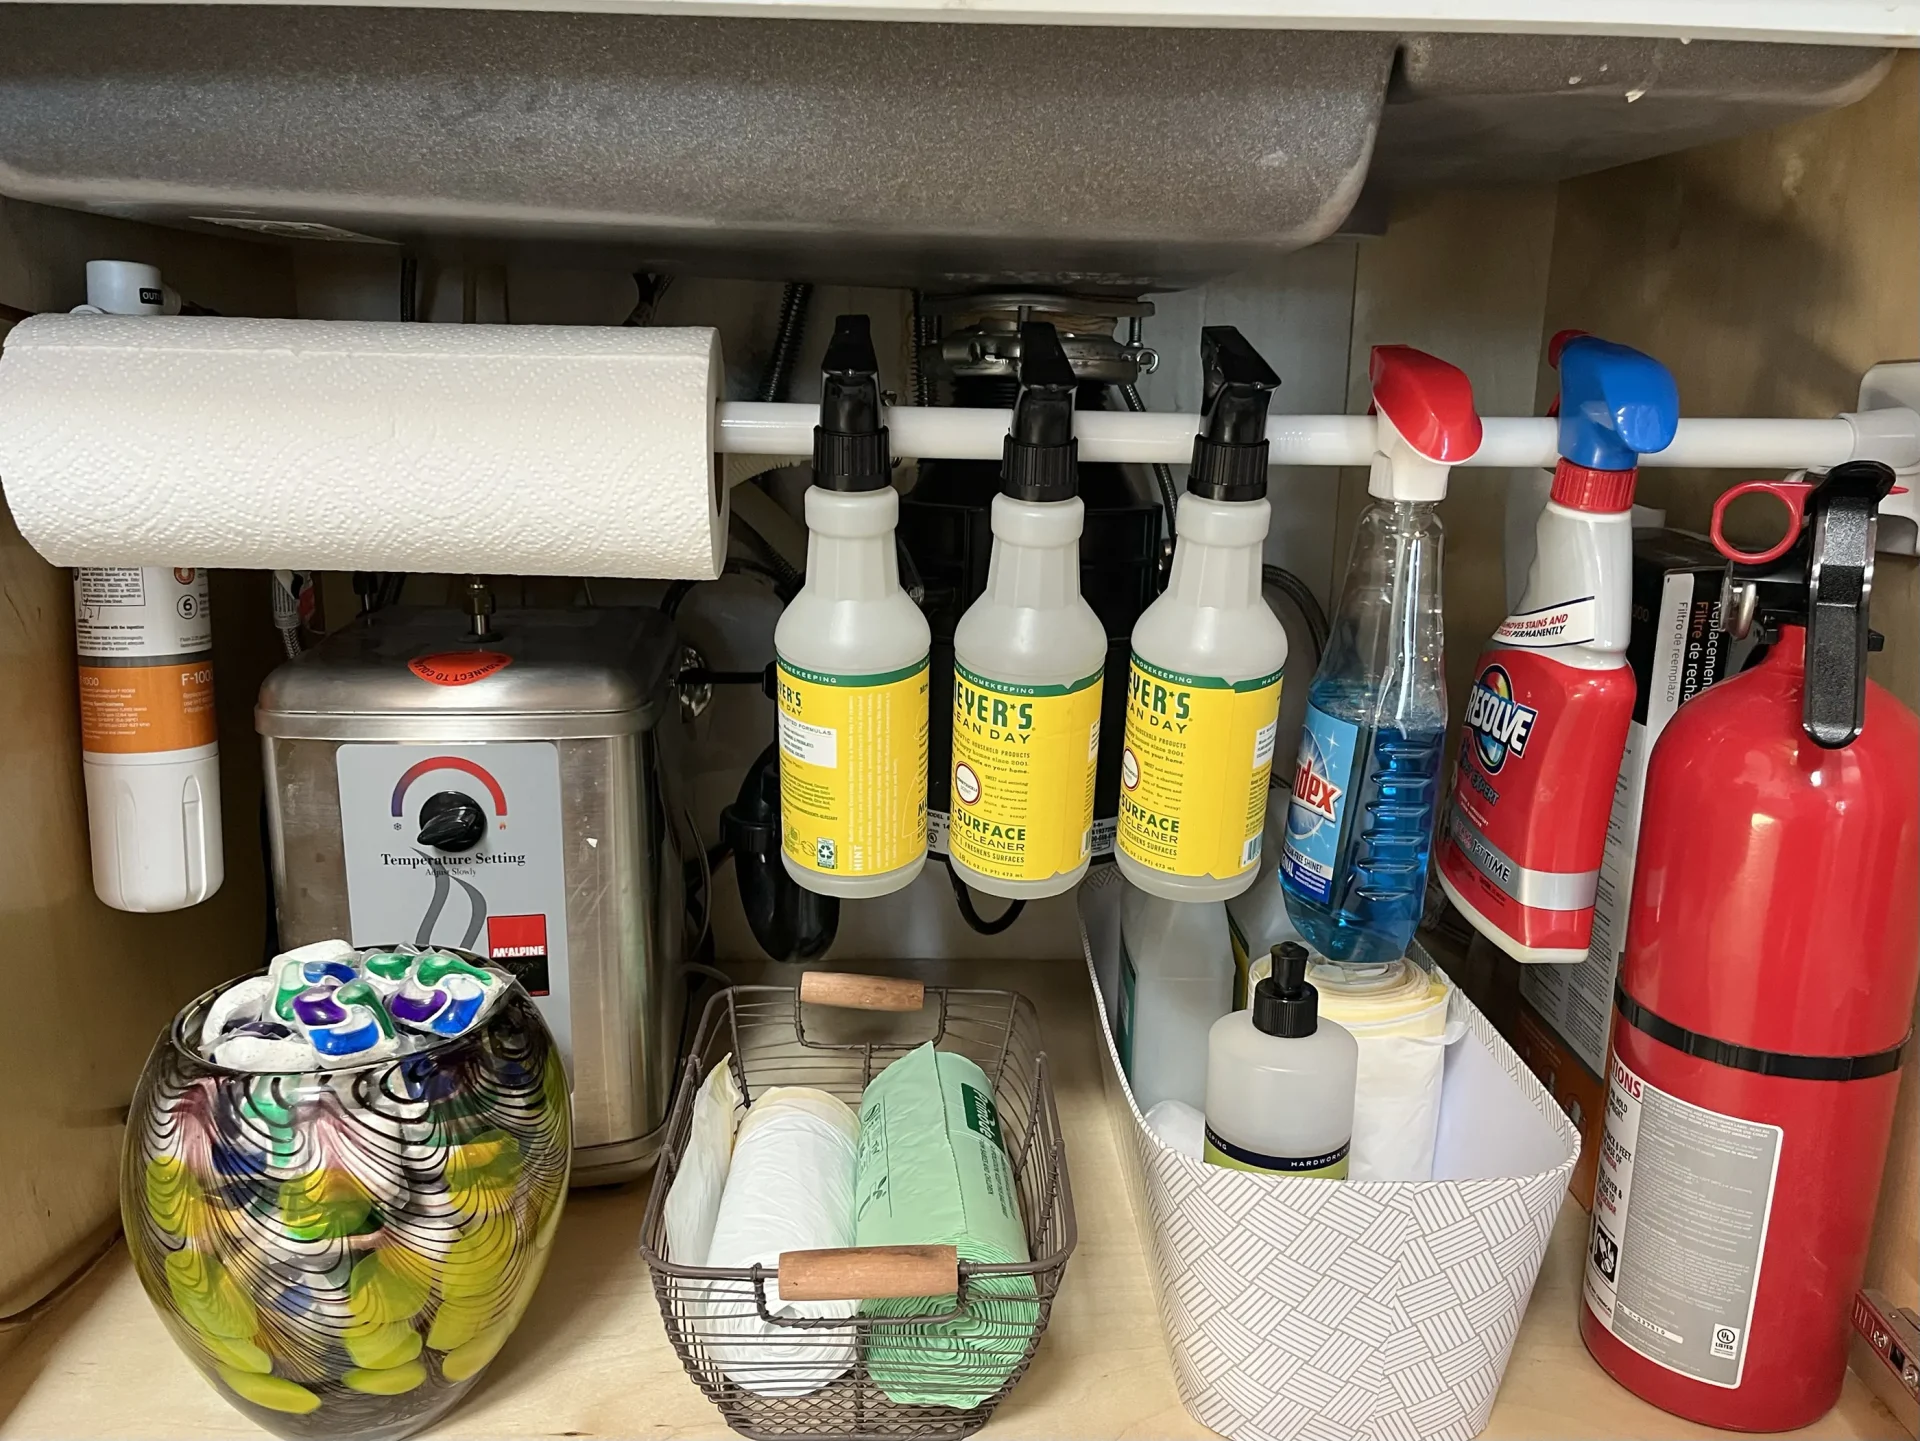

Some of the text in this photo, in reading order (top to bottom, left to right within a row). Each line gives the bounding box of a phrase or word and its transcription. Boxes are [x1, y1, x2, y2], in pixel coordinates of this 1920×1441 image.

[183, 598, 192, 612] 6
[1525, 617, 1548, 629] STAINS
[1549, 613, 1569, 625] AND
[1692, 602, 1709, 638] Filtre
[1510, 624, 1566, 638] PERMANENTLY
[1666, 602, 1688, 702] Filtro de reemplazo
[1689, 642, 1703, 660] de
[435, 672, 449, 681] TO
[1136, 658, 1193, 684] HOMEKEEPING
[968, 674, 1034, 694] HOMEKEEPING
[1150, 715, 1188, 734] DAY
[1464, 685, 1534, 752] RESOLVE
[990, 728, 1031, 744] DAY
[1158, 738, 1187, 749] PRODUCTS
[1000, 750, 1030, 759] PRODUCTS
[1471, 771, 1500, 806] EXPERT
[1125, 815, 1178, 845] CLEANER
[965, 829, 1025, 852] CLEANER
[1147, 841, 1177, 857] SURFACES
[380, 852, 526, 869] Temperature Setting
[854, 844, 863, 872] HINT
[992, 853, 1025, 863] SURFACES
[1482, 849, 1512, 884] TIME
[425, 868, 477, 878] Adjust Slowly
[1721, 1331, 1730, 1342] UL
[1715, 1342, 1734, 1351] LISTED
